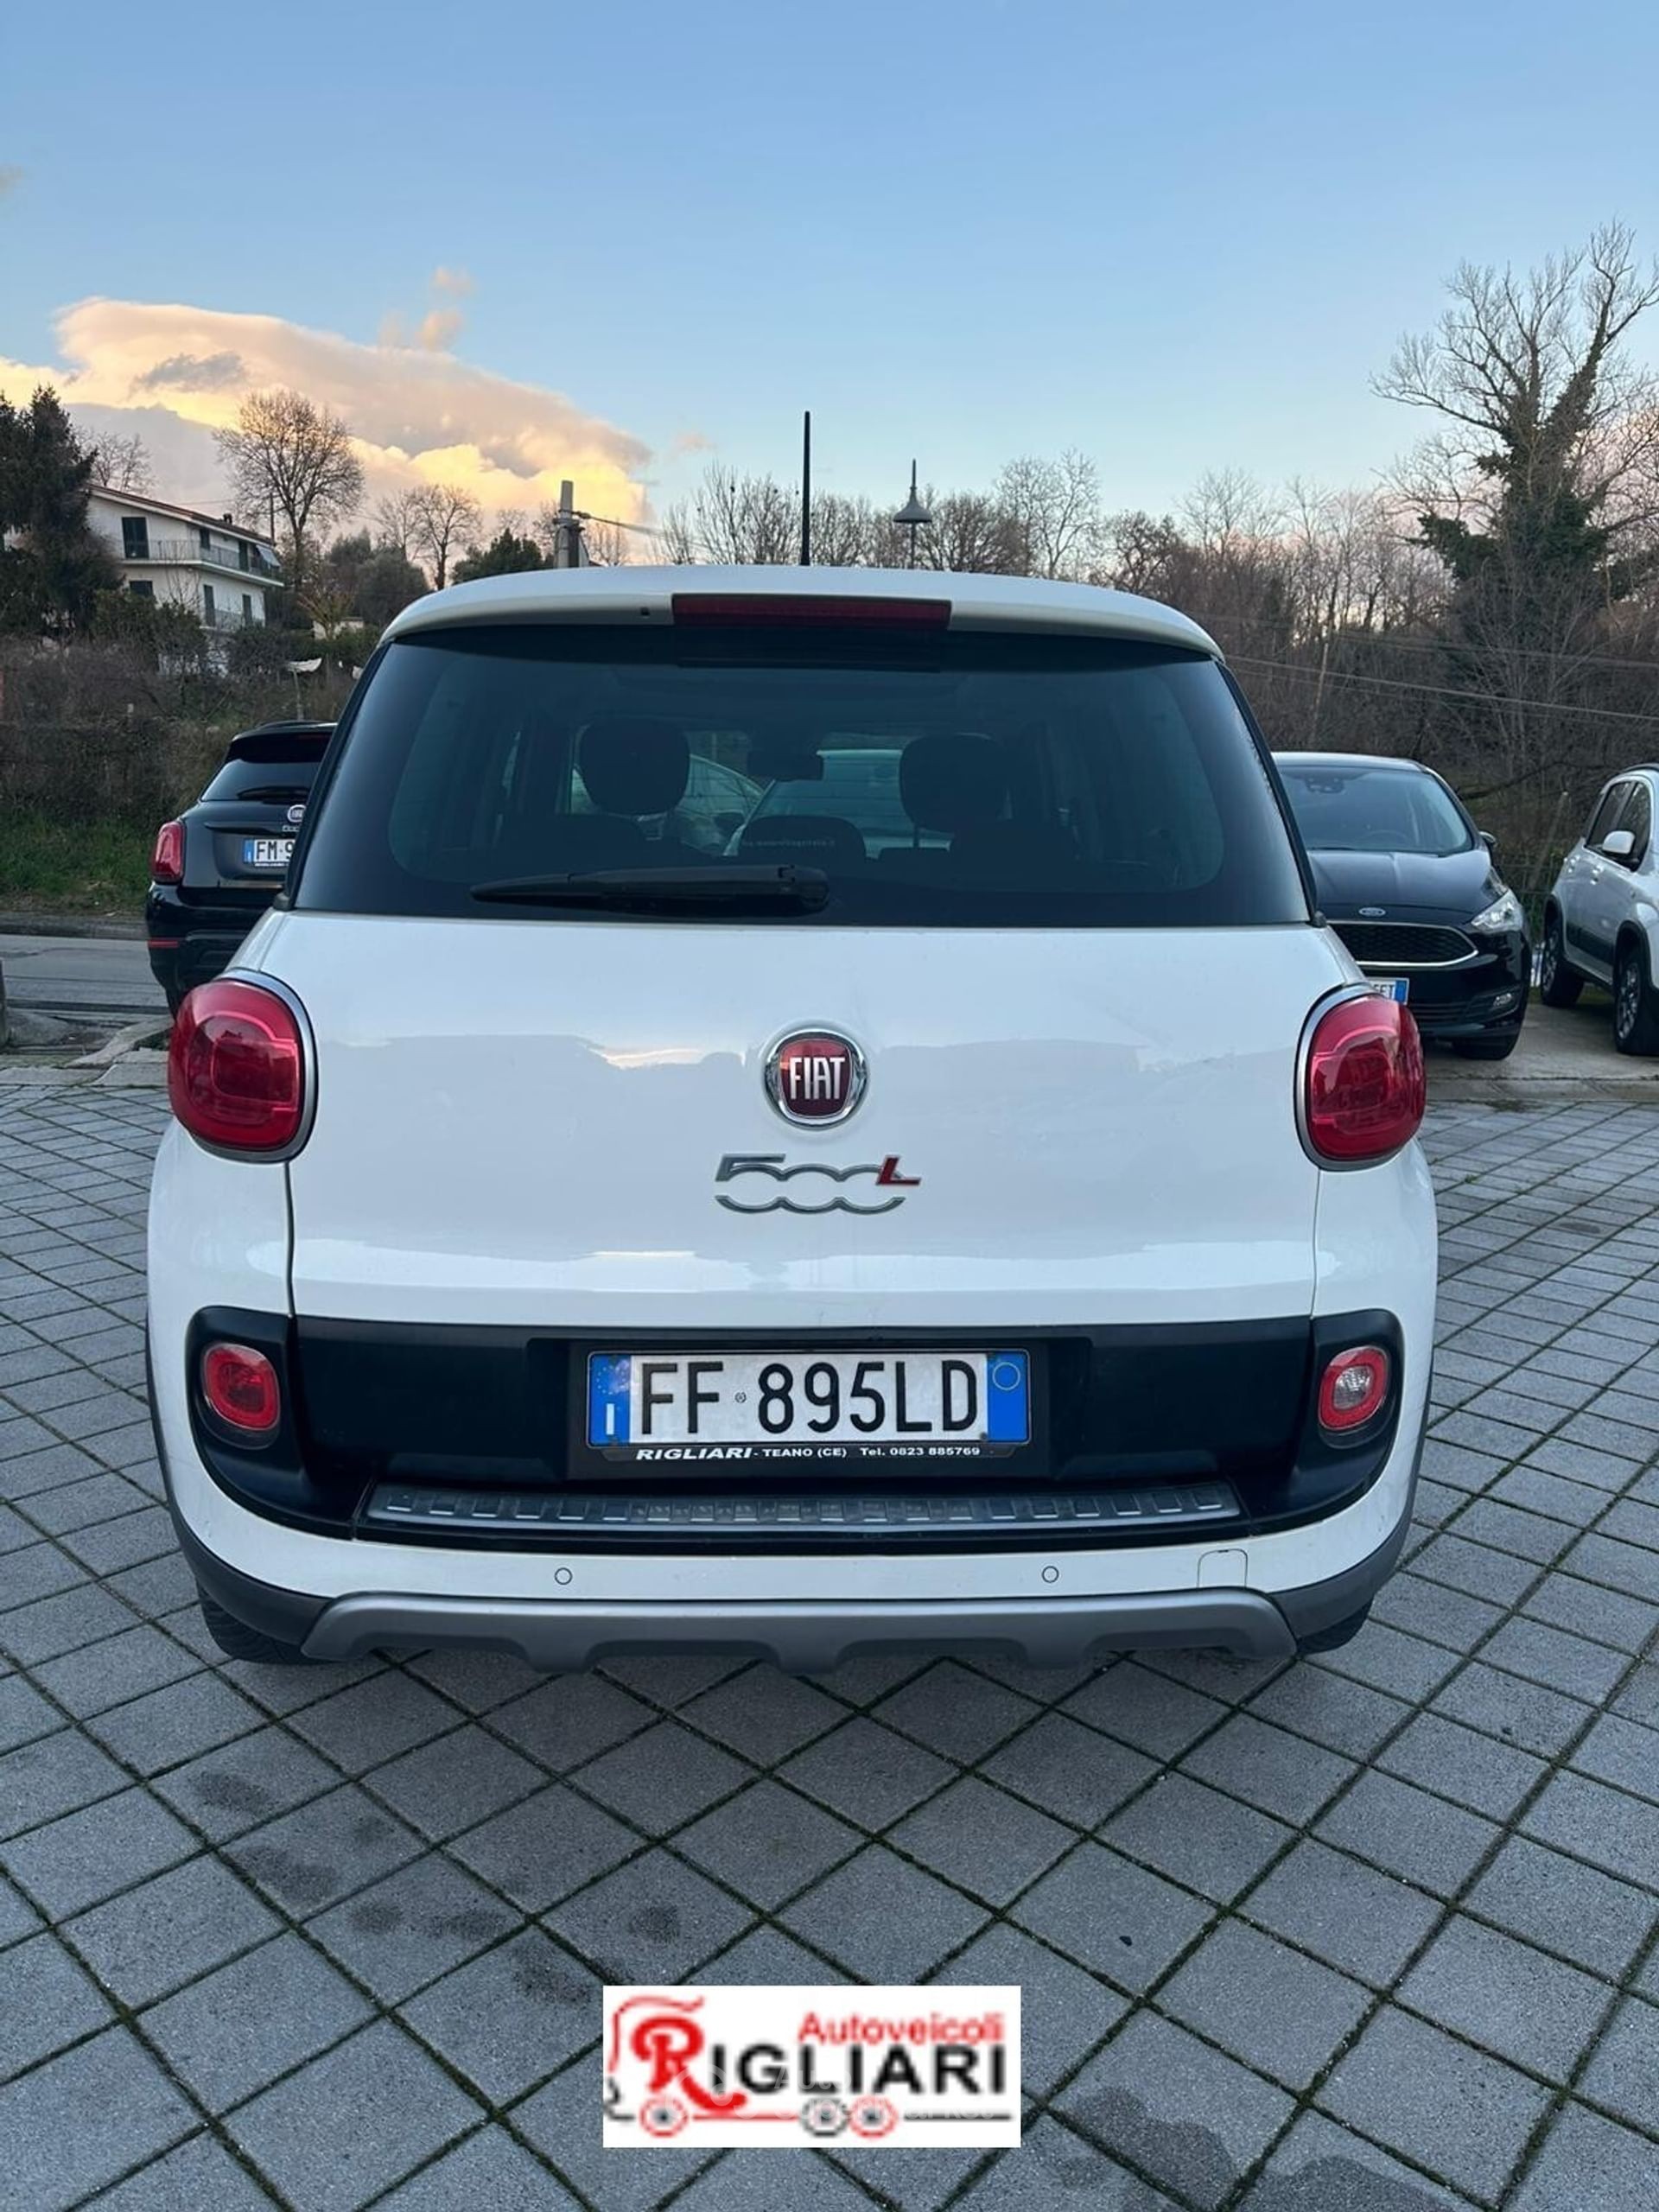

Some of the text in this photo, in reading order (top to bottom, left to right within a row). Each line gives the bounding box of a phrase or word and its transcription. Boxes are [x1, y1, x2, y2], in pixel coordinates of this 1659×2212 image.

[257, 842, 277, 860] FM
[790, 1057, 845, 1100] FIAT
[715, 1153, 922, 1215] 500L
[642, 1362, 724, 1435] FF
[758, 1359, 978, 1435] 895LD
[762, 1448, 812, 1458] TEANO
[817, 1447, 848, 1458] (CE)
[860, 1447, 886, 1457] Tel.
[890, 1447, 925, 1457] 0823
[928, 1447, 980, 1457] 885769
